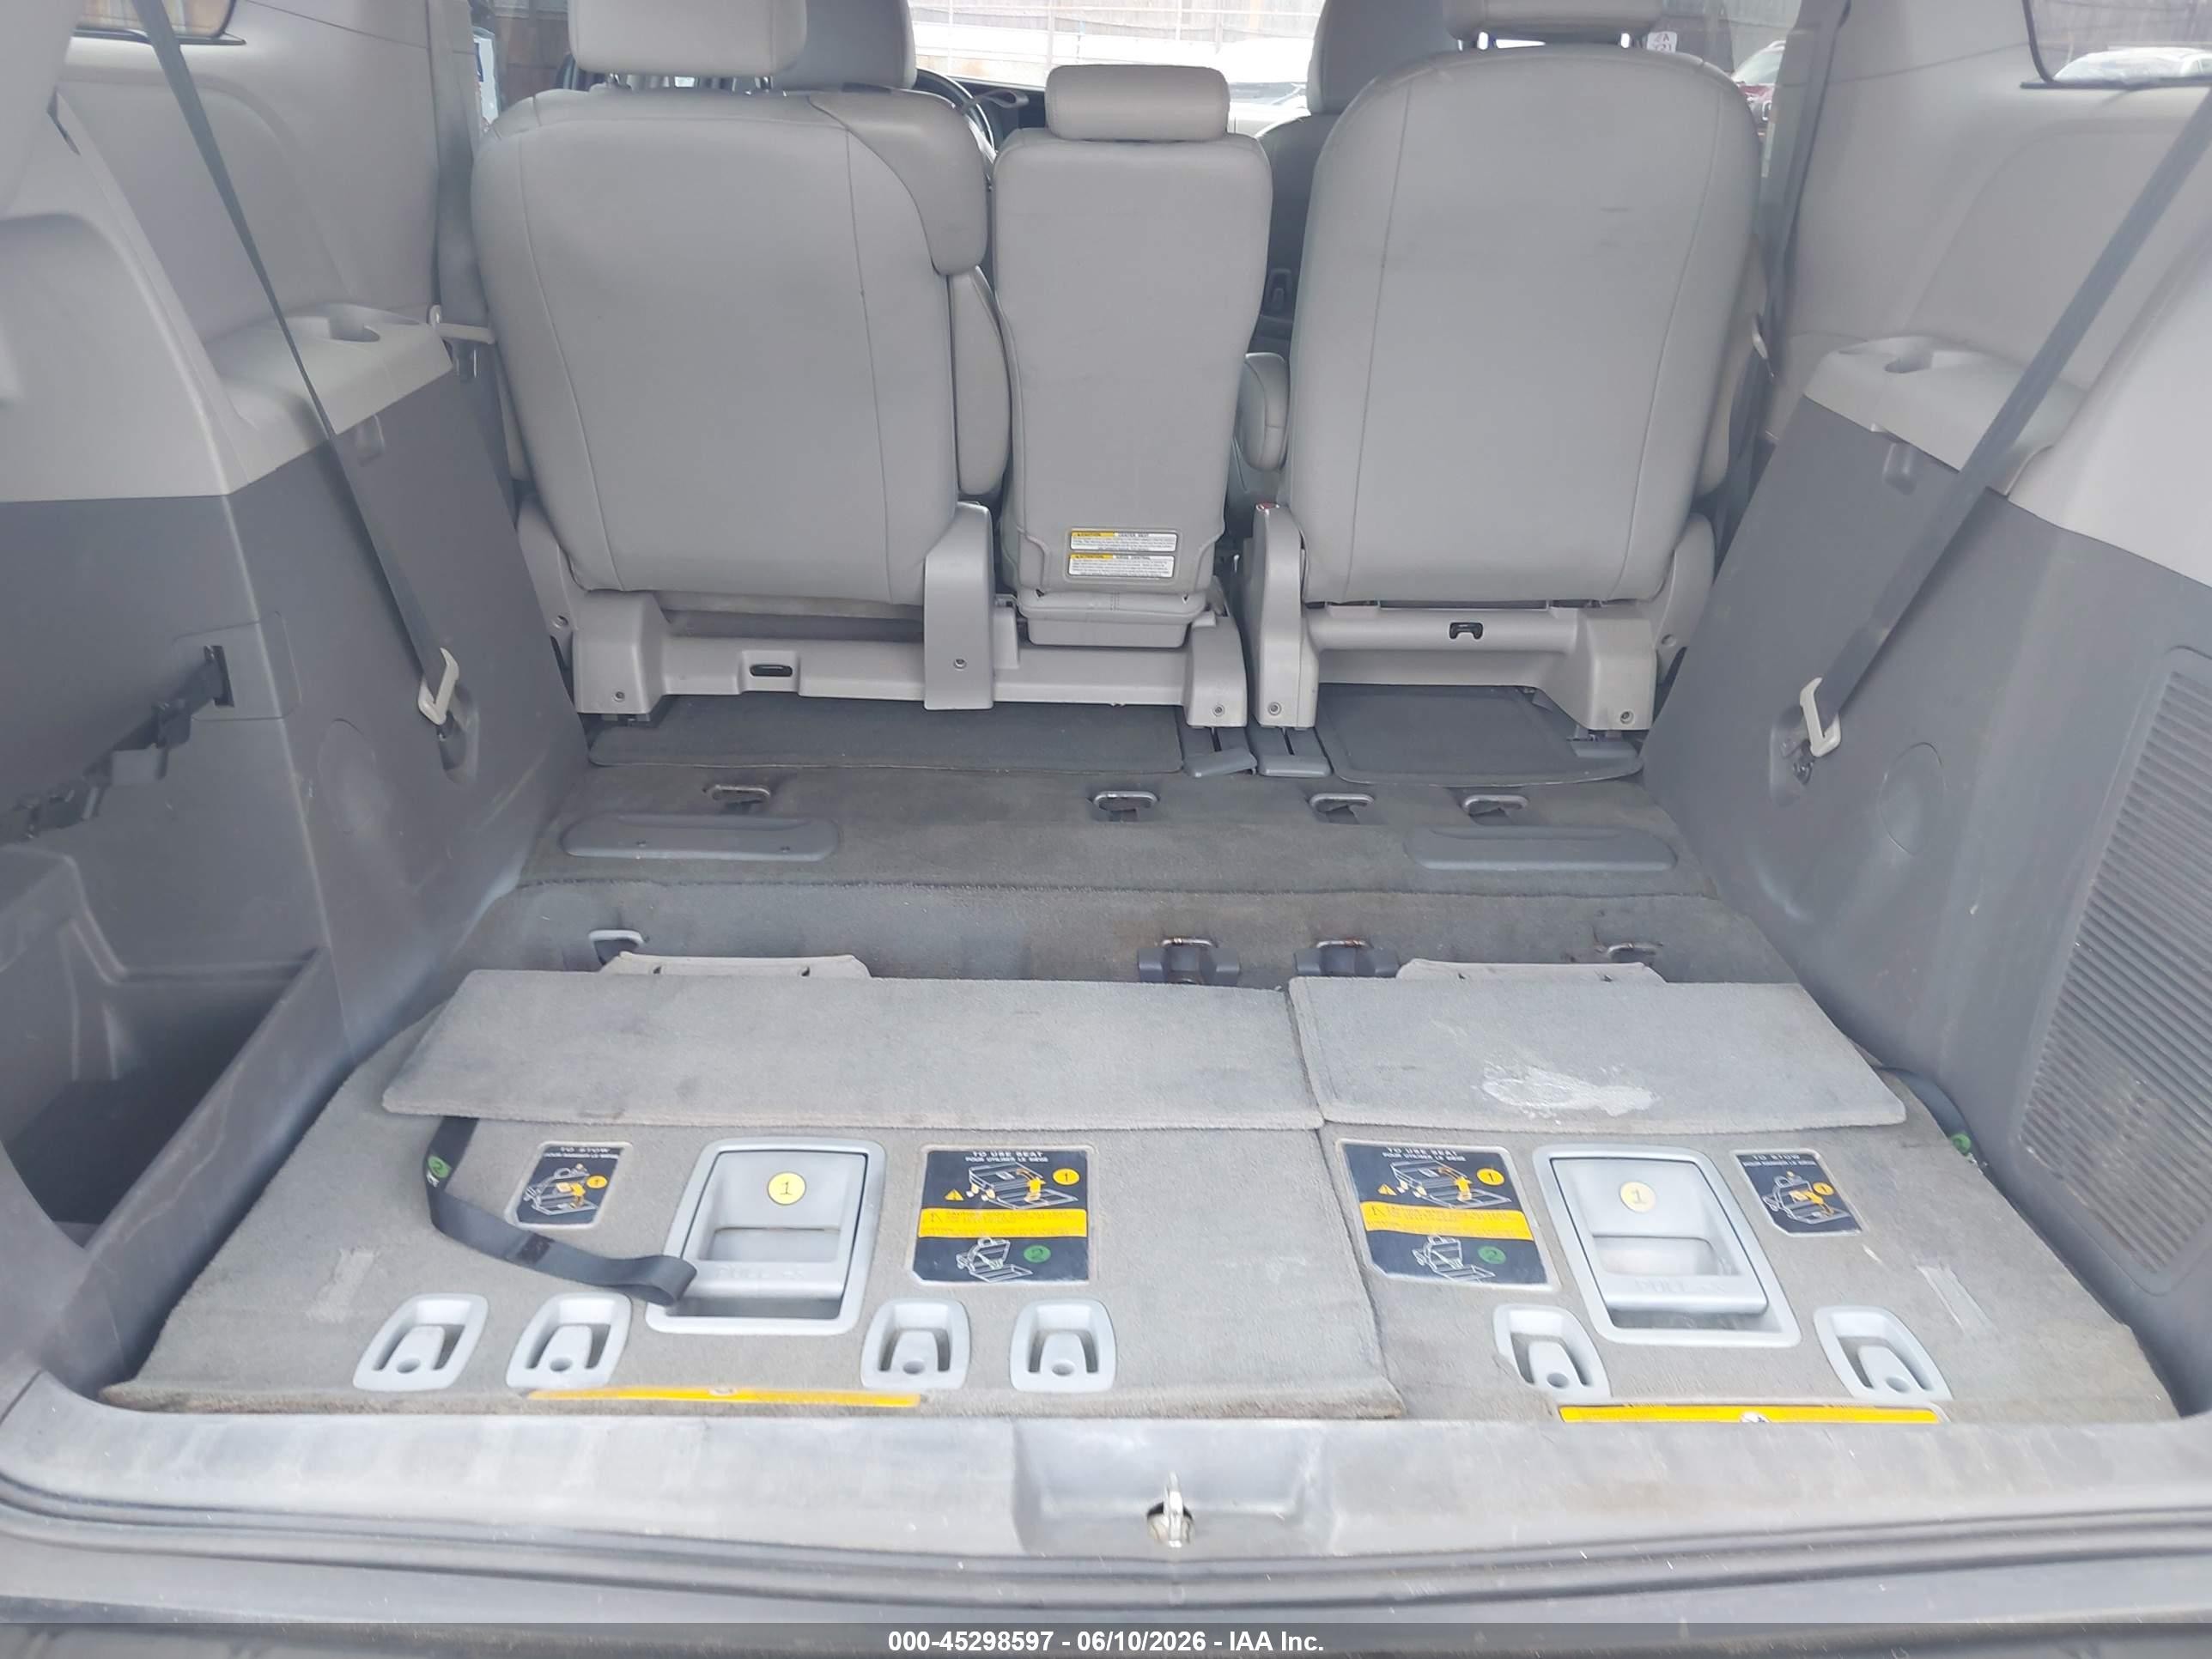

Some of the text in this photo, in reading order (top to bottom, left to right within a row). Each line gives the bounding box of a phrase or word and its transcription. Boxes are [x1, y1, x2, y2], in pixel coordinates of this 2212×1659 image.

[1431, 1148, 1457, 1157] SEAT
[780, 1181, 793, 1195] 1
[1631, 1188, 1647, 1205] 1
